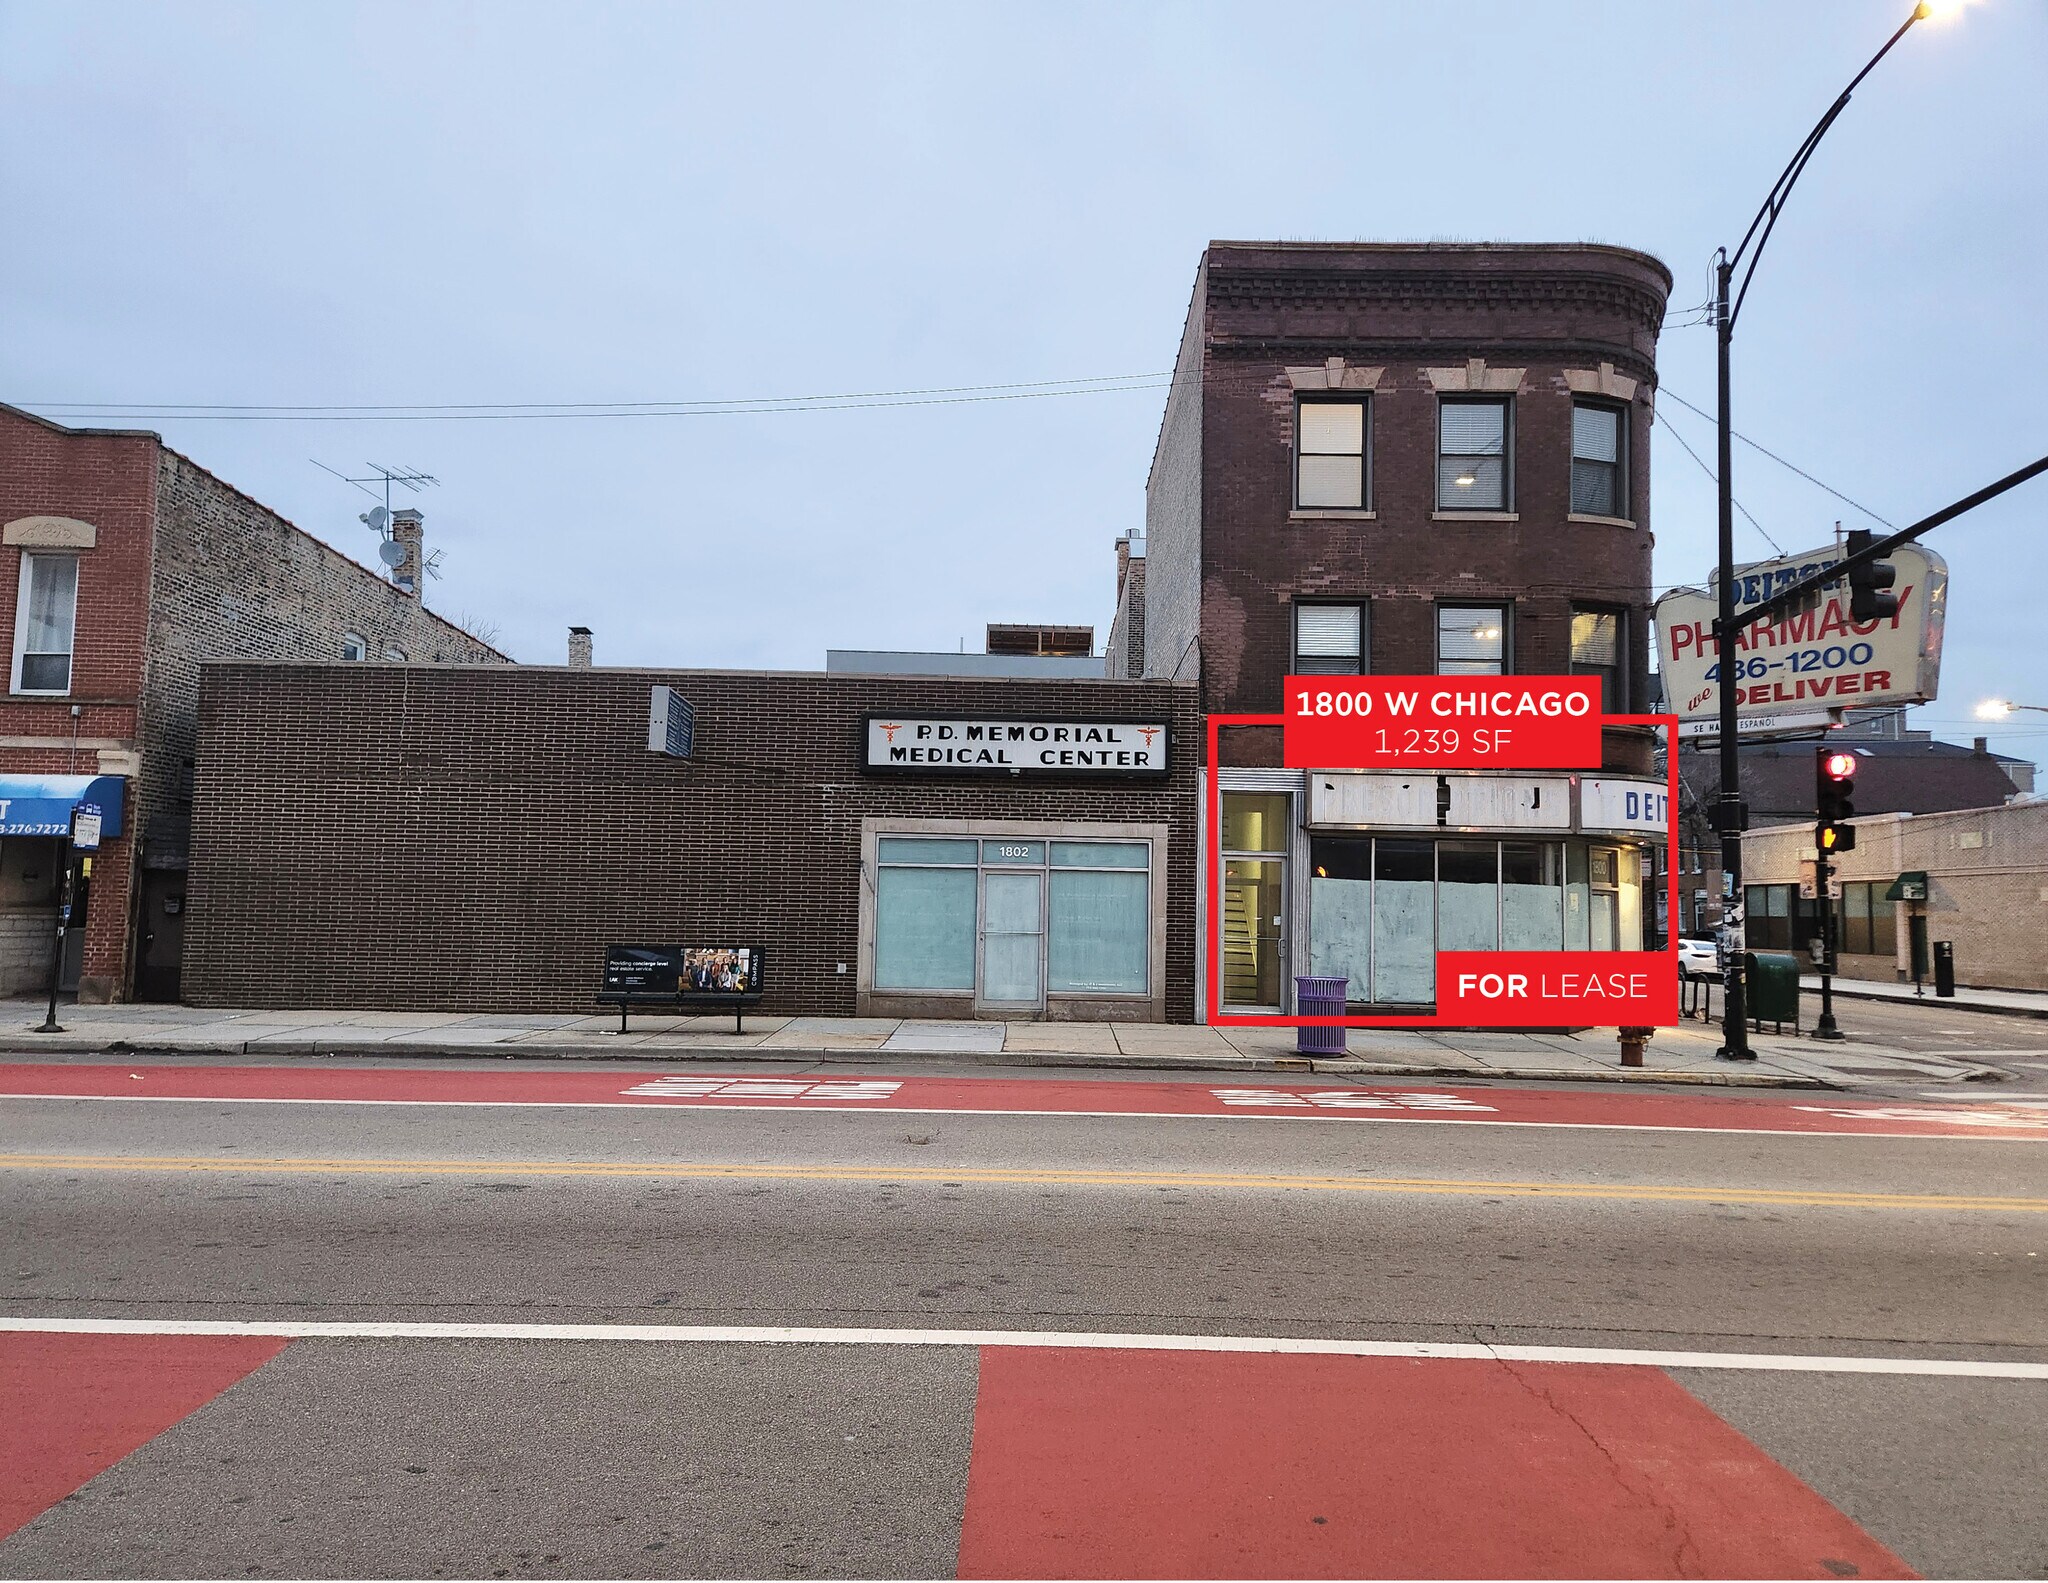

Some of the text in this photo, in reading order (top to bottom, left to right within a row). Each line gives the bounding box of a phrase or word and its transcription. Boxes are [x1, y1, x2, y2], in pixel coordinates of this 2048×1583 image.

[1688, 687, 1713, 712] we
[966, 726, 1122, 743] MEMORIAL
[1693, 725, 1704, 733] SE
[890, 747, 1149, 766] MEDICAL CENTER
[999, 846, 1029, 857] 1802
